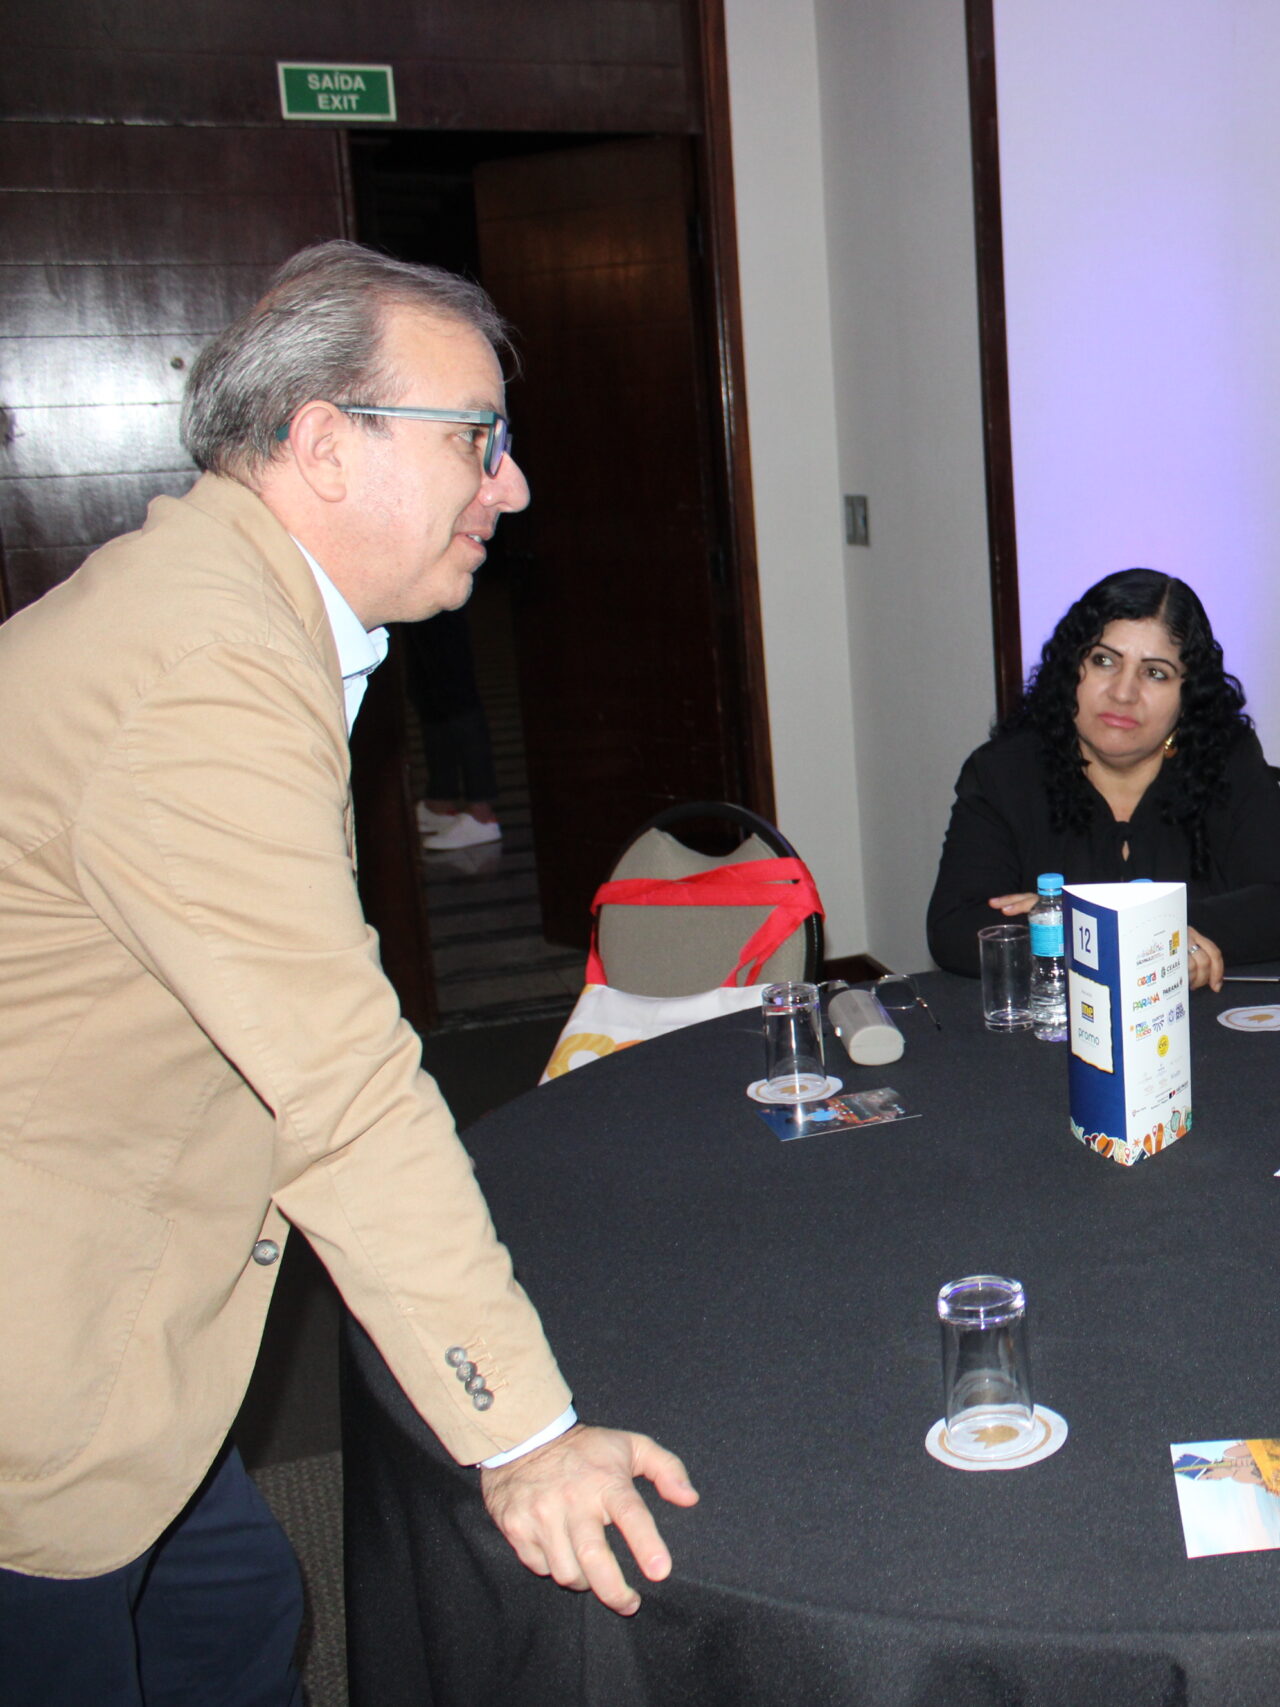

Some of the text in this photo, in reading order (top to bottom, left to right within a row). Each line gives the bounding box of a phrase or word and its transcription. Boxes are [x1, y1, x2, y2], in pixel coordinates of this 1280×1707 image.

[307, 72, 366, 92] SAÍDA
[317, 94, 360, 111] EXIT
[1079, 926, 1091, 953] 12
[1078, 1027, 1100, 1046] promo
